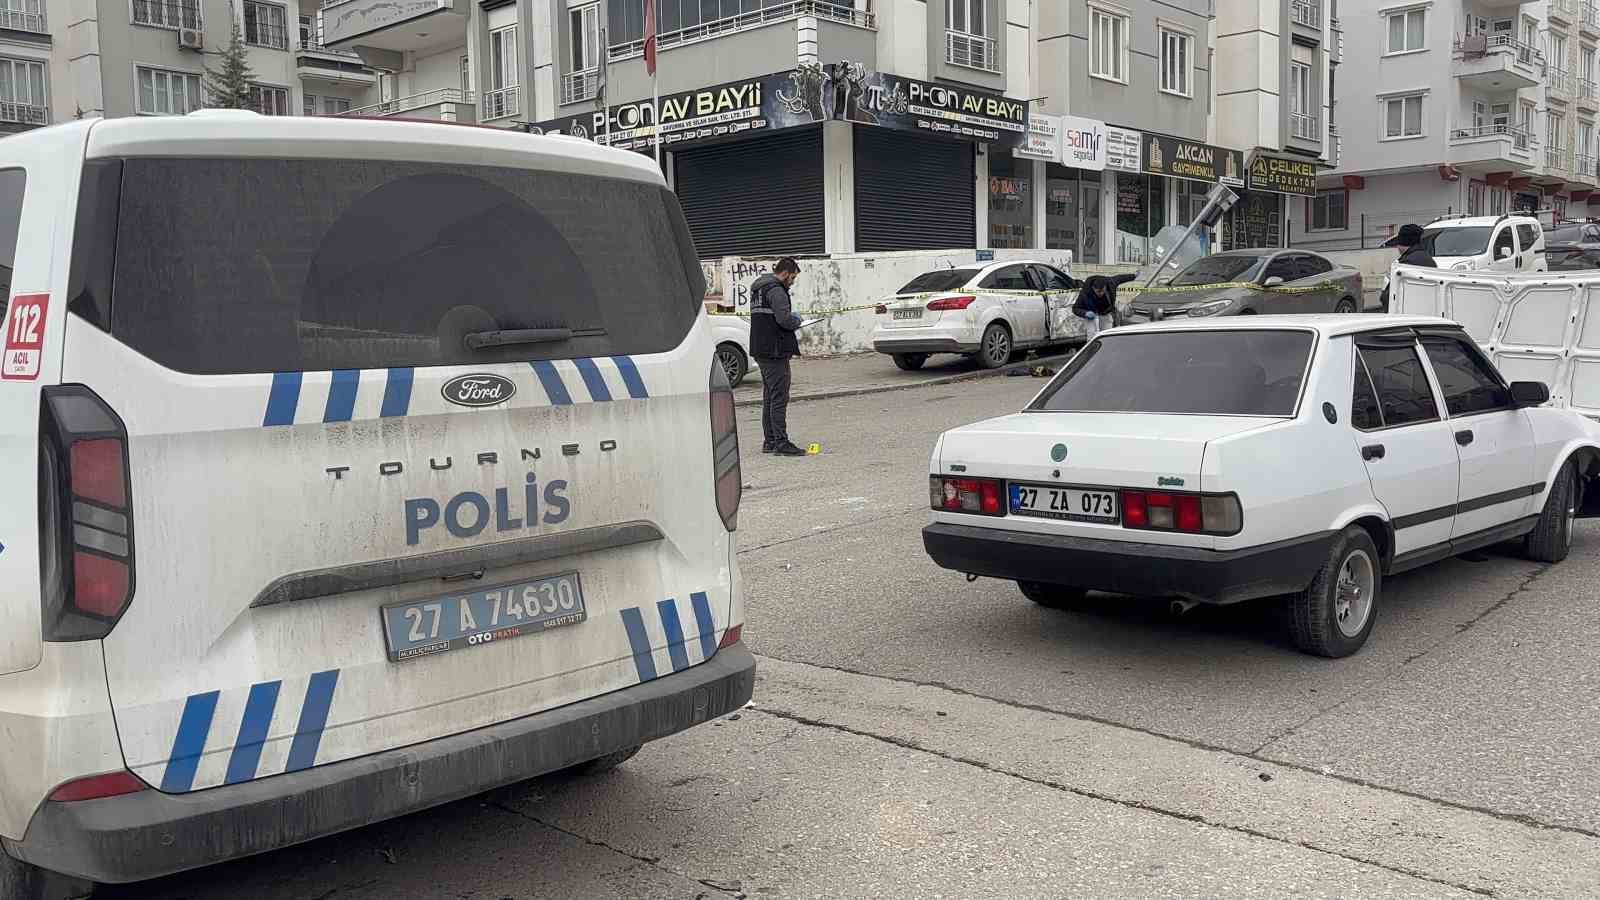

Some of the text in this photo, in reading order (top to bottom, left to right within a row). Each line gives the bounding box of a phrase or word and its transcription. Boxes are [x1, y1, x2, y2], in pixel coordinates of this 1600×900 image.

[660, 95, 691, 122] AV
[963, 94, 983, 113] AV
[1067, 126, 1102, 160] samir
[12, 304, 40, 344] 112
[458, 379, 502, 400] Ford
[326, 439, 617, 480] TOURNEO
[1020, 488, 1113, 514] 27 ZA 073
[405, 579, 575, 642] 27 A 74630
[468, 632, 492, 645] OTO
